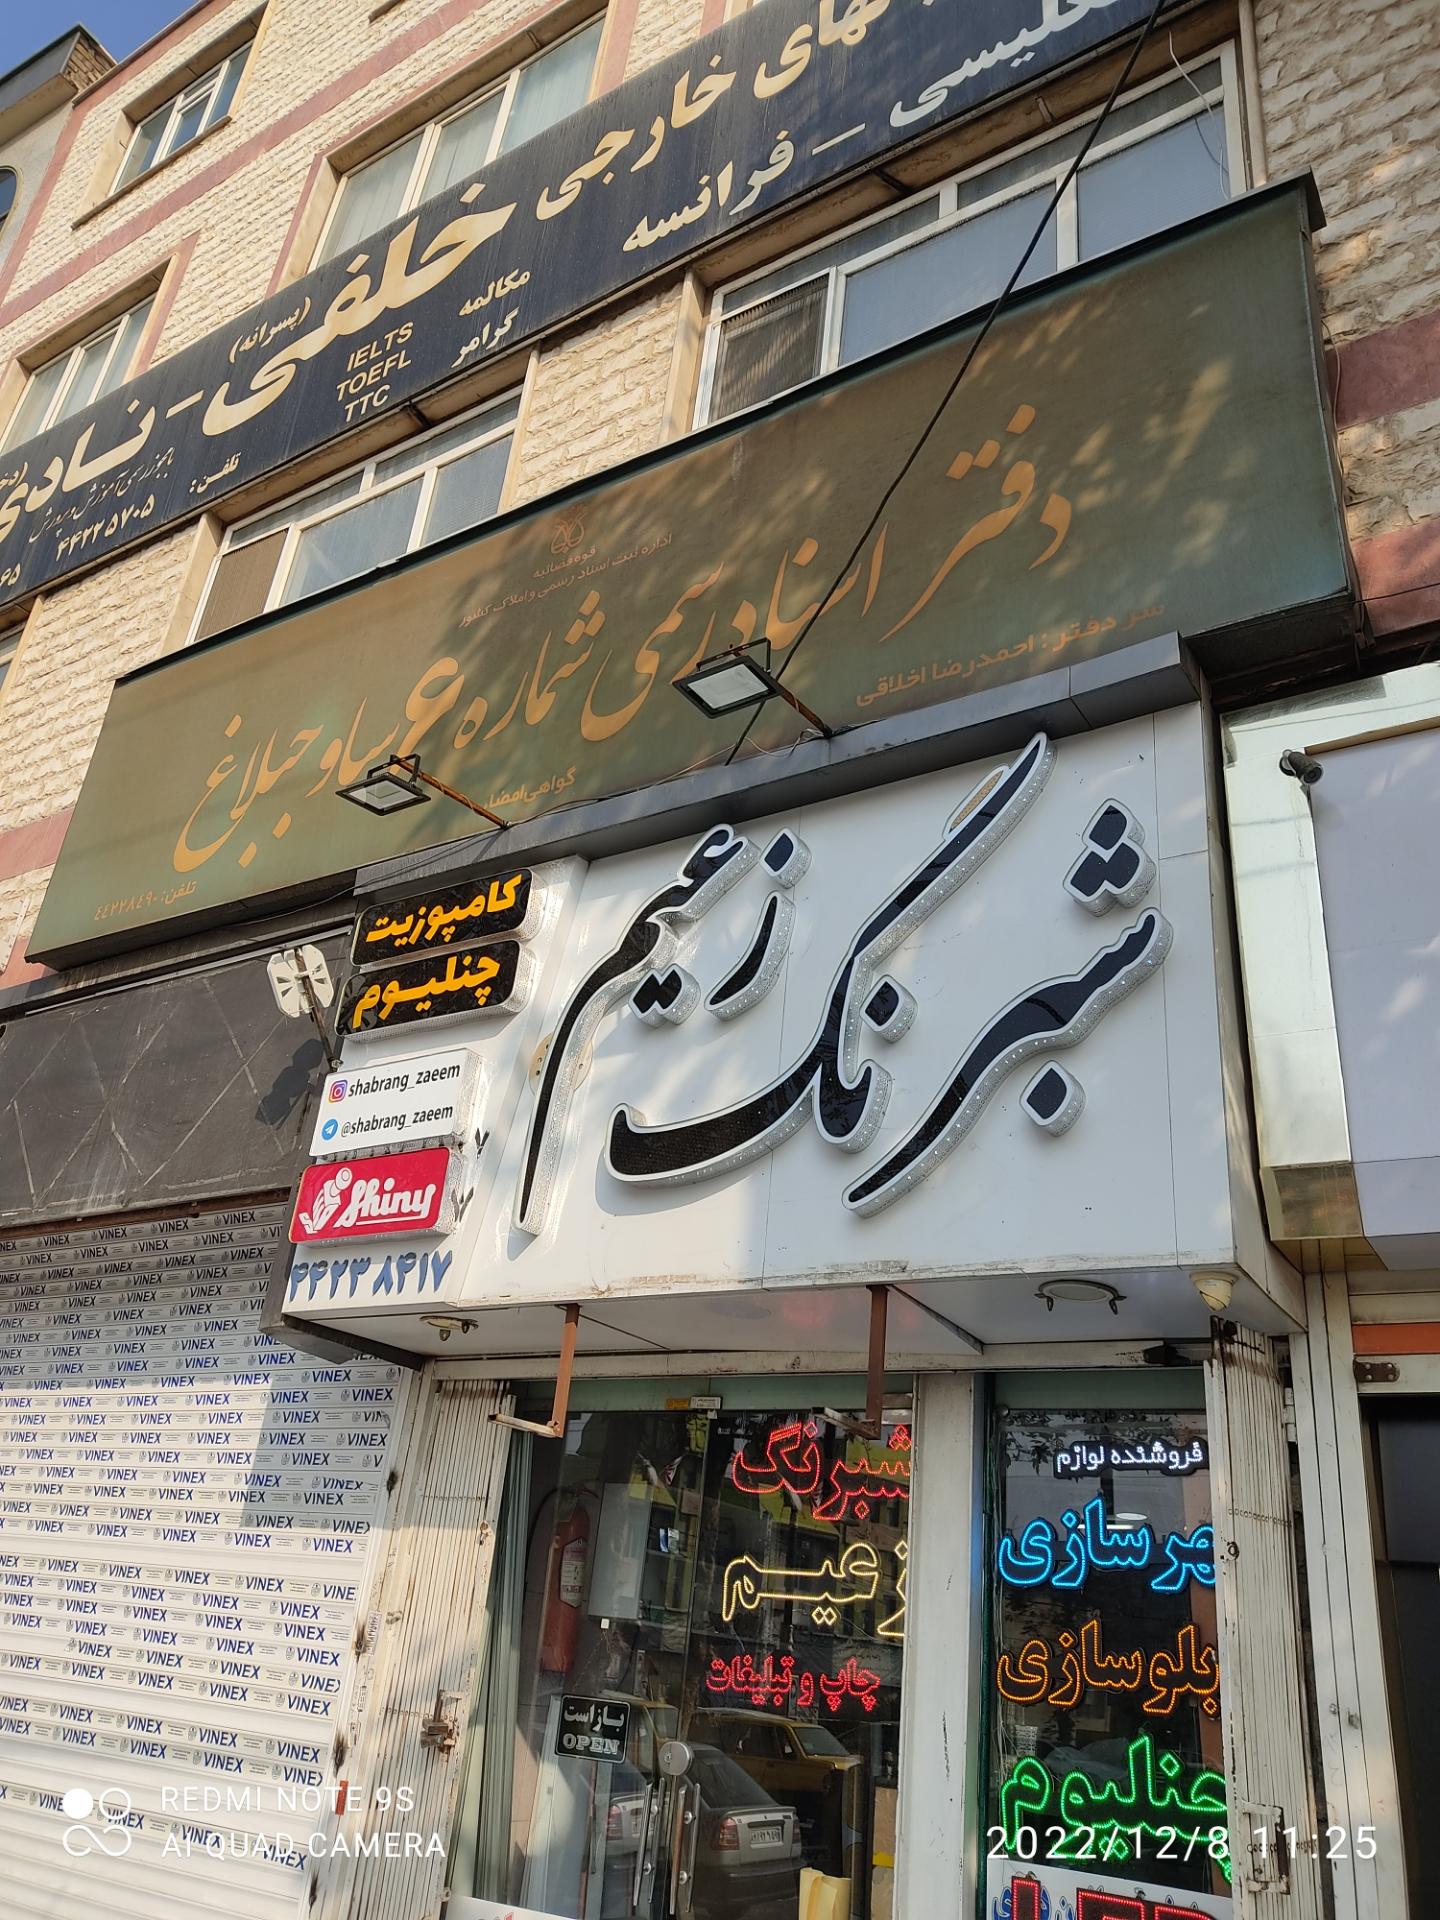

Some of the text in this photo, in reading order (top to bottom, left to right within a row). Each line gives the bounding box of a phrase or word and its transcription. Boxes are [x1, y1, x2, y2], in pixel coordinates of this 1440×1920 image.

[536, 55, 737, 220] خارجی
[622, 130, 795, 252] فرانسه
[459, 269, 531, 316] مکالمه
[202, 183, 517, 436] خلفی
[347, 321, 413, 371] IELTS
[451, 307, 519, 367] گرامر
[336, 350, 411, 401] TOEFL
[344, 384, 390, 422] TTC
[877, 404, 1072, 643] دفتر
[641, 533, 672, 556] اداره
[577, 557, 609, 581] اسناد
[538, 574, 574, 599] رسمی
[731, 521, 889, 652] اسناد
[580, 561, 725, 741] رسمی
[453, 591, 606, 750] شماره
[856, 666, 926, 707] اخلاقی
[366, 874, 522, 947] کامپوزیت
[603, 732, 1170, 1214] شبرنگ
[352, 954, 501, 1029] چنلیوم
[348, 1062, 461, 1098] shabrang_zaeem
[341, 1104, 453, 1138] @shabrang_zaeem
[334, 1177, 437, 1229] Shiny
[43, 1219, 189, 1247] VINEX VINEX VINEX
[80, 1232, 234, 1259] VINEX VINEX VINEX
[165, 1247, 264, 1268] VINEX VINEX
[21, 1267, 228, 1296] VINEX VINEX VINEX
[14, 1285, 223, 1312] VINEX VINEX VINEX
[53, 1303, 212, 1325] VINEX VINEX
[13, 1319, 239, 1344] VINEX VINEX VINEX
[52, 1342, 146, 1356] VINEX VINEX
[117, 1352, 296, 1372] VINEX VINEX VINEX
[95, 1378, 126, 1390] VINEX
[161, 1376, 195, 1388] VINEX
[234, 1373, 270, 1385] VINEX
[63, 1391, 310, 1407] VINEX VINEX VINEX
[140, 1413, 172, 1424] VINEX
[208, 1412, 243, 1424] VINEX
[283, 1411, 320, 1423] VINEX
[130, 1432, 162, 1444] VINEX
[197, 1432, 230, 1444] VINEX
[269, 1432, 306, 1445] VINEX
[85, 1450, 252, 1464] VINEX VINEX VINEX
[1057, 1441, 1203, 1473] فروشنده لوازم
[34, 1483, 344, 1506] VINEX VINEX VINEX VINEX
[107, 1469, 282, 1488] VINEX VINEX VINEX
[60, 1504, 294, 1529] VINEX VINEX VINEX
[35, 1520, 353, 1553] VINEX VINEX VINEX VINEX
[48, 1559, 284, 1592] VINEX VINEX VINEX
[66, 1579, 320, 1620] VINEX VINEX VINEX
[66, 1599, 326, 1641] VINEX VINEX VINEX
[12, 1613, 340, 1666] VINEX VINEX VINEX VINEX
[147, 1650, 260, 1680] VINEX VINEX
[10, 1655, 331, 1716] VINEX VINEX VINEX VINEX
[706, 1654, 881, 1712] چاپ و تبلیغات
[127, 1715, 163, 1734] VINEX
[199, 1728, 238, 1748] VINEX
[278, 1741, 320, 1764] VINEX
[562, 1732, 620, 1755] OPEN
[131, 1740, 244, 1773] VINEX VINEX
